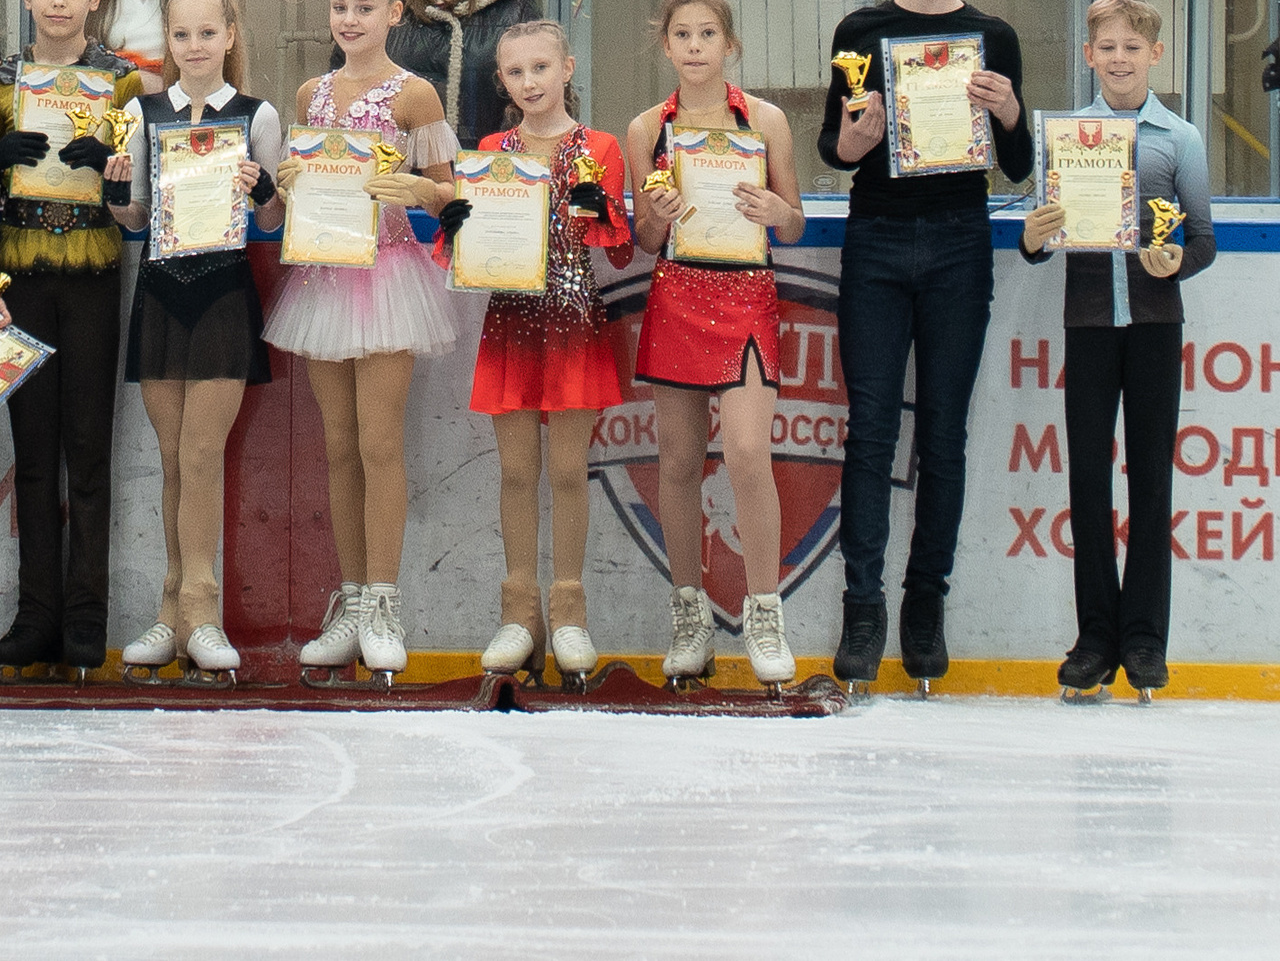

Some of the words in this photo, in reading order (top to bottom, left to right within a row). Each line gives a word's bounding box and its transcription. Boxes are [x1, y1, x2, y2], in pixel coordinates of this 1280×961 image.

[37, 97, 93, 112] ГРАМОТА
[307, 163, 362, 175] ГРАМОТА
[693, 157, 747, 171] ГРАМОТА
[1058, 158, 1124, 169] ГРАМОТА
[474, 186, 530, 198] ГРАМОТА
